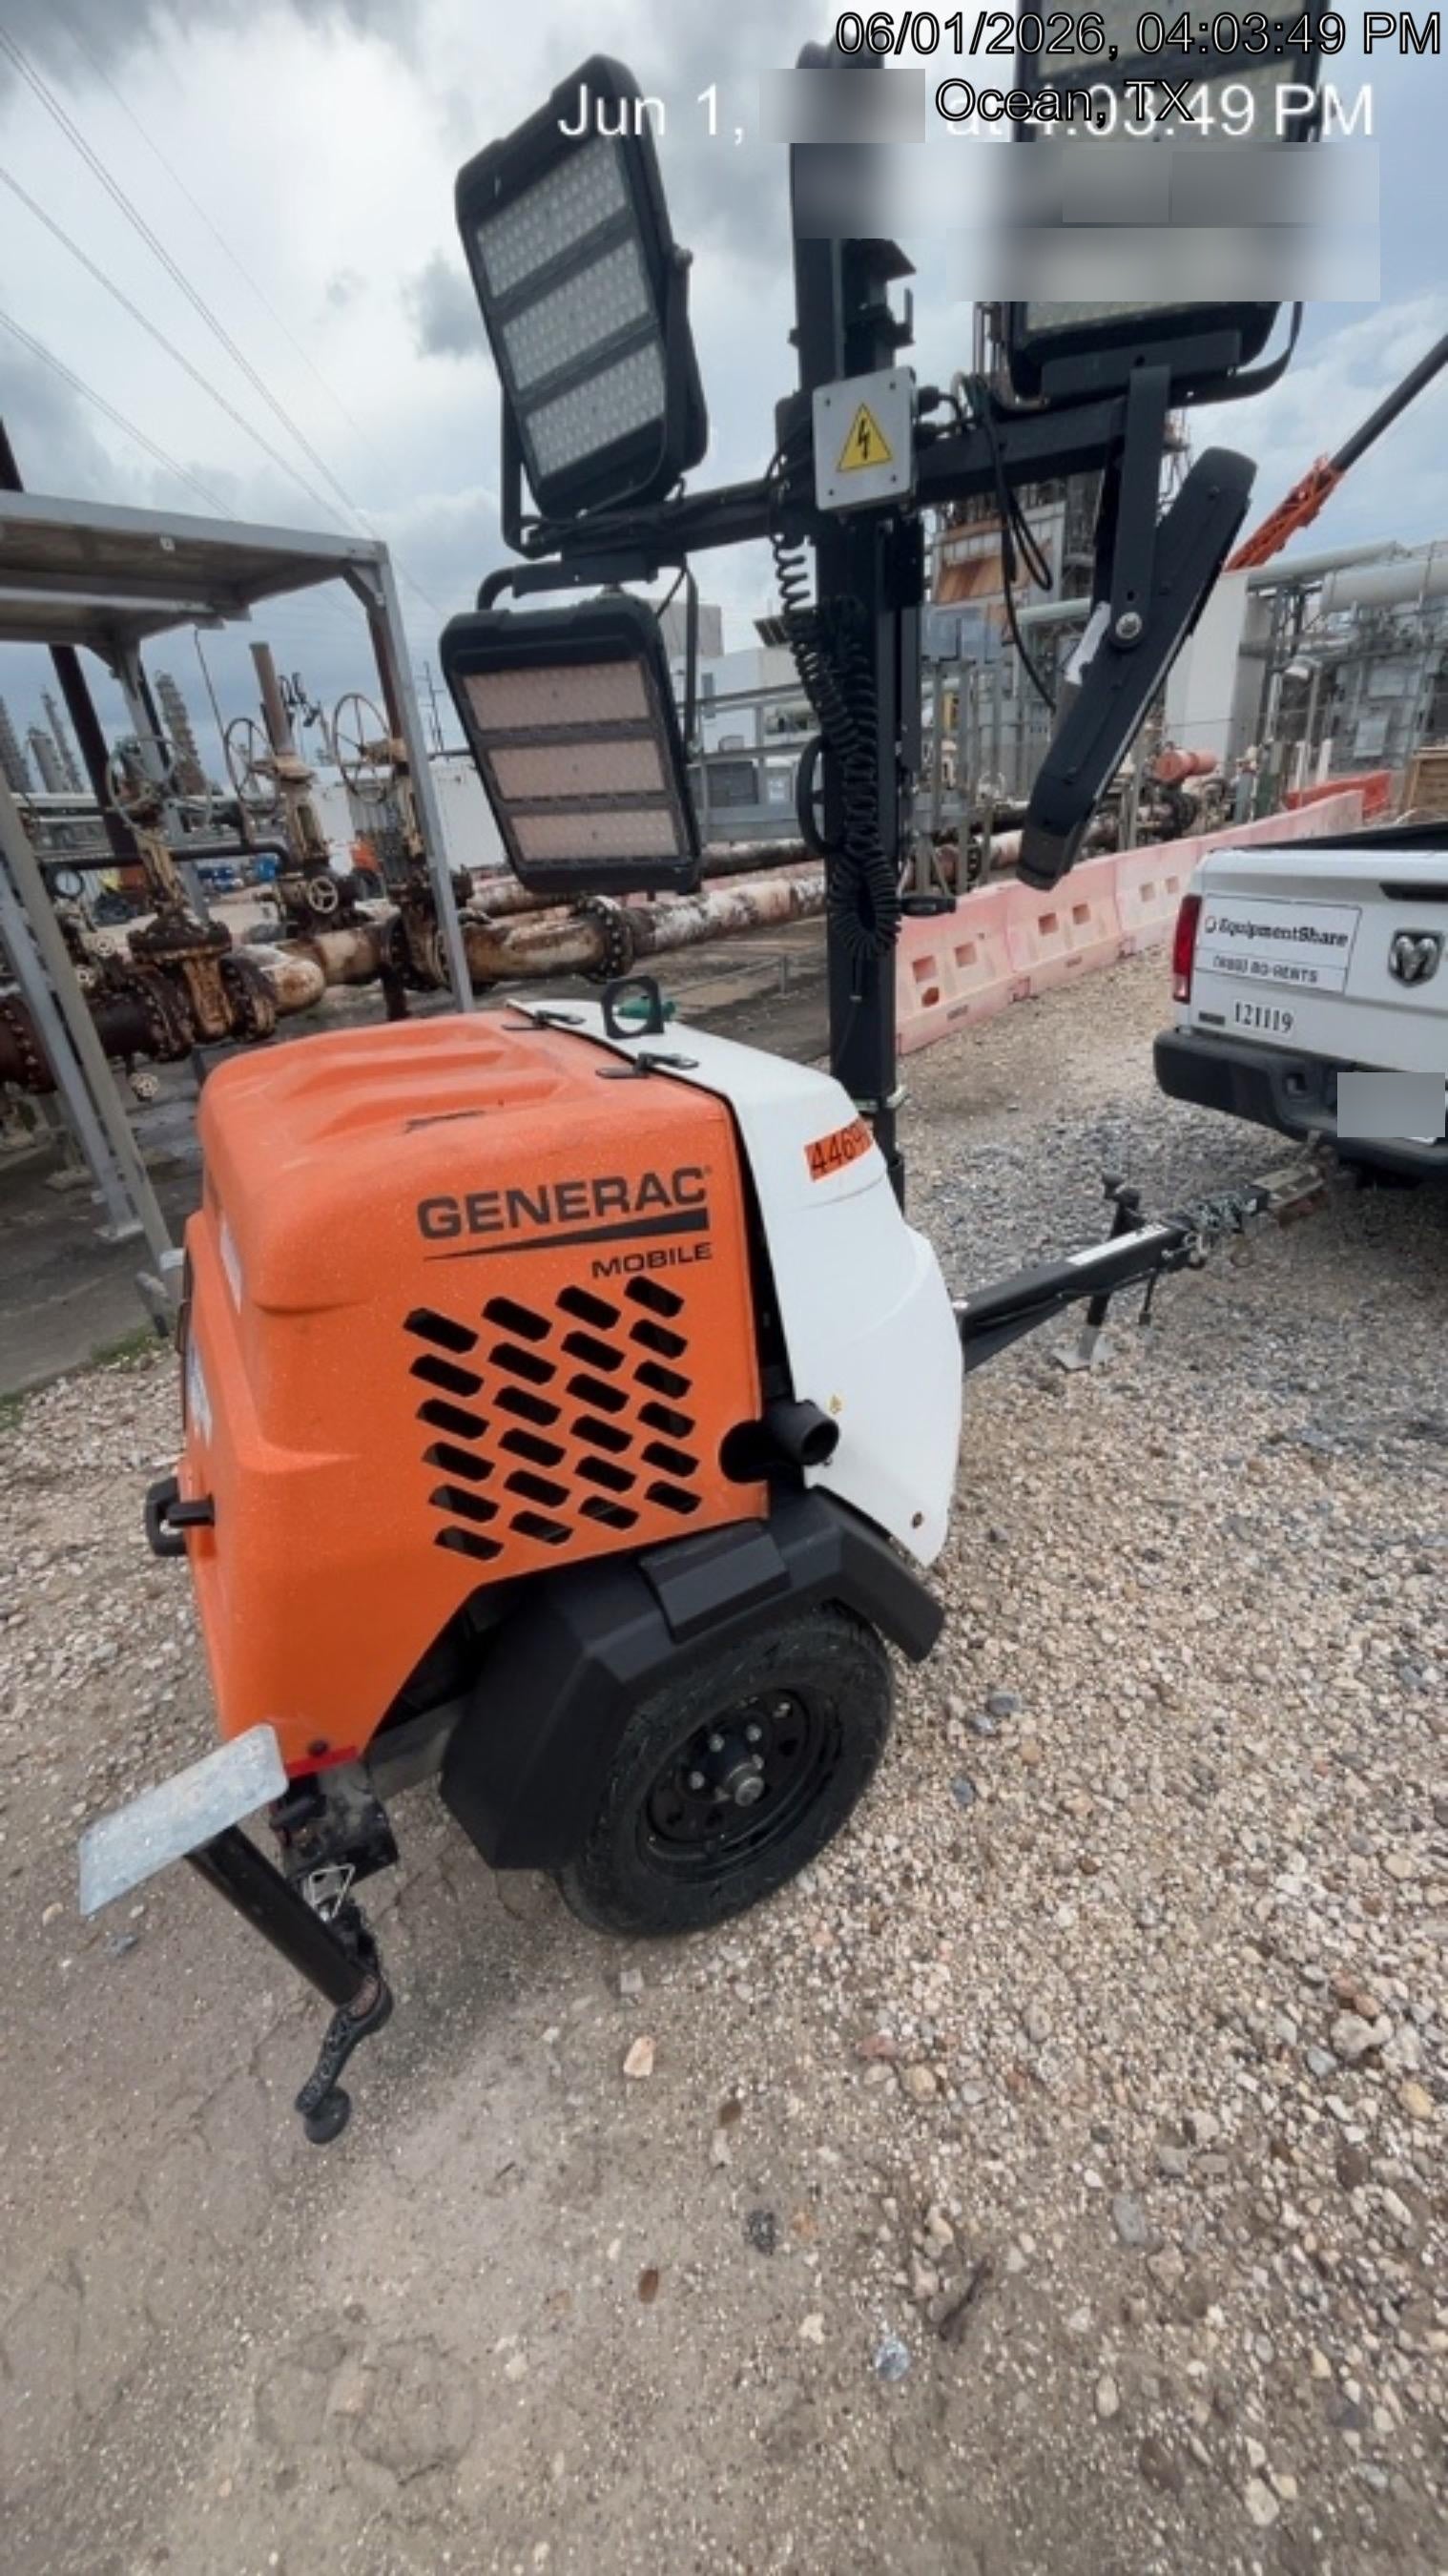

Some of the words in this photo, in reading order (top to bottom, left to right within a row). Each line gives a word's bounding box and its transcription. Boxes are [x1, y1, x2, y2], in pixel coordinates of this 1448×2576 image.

[1219, 918, 1348, 947] EquipmentShare
[1235, 1001, 1294, 1034] 121119
[417, 1166, 708, 1240] GENERAC
[590, 1241, 714, 1279] MOBILE
